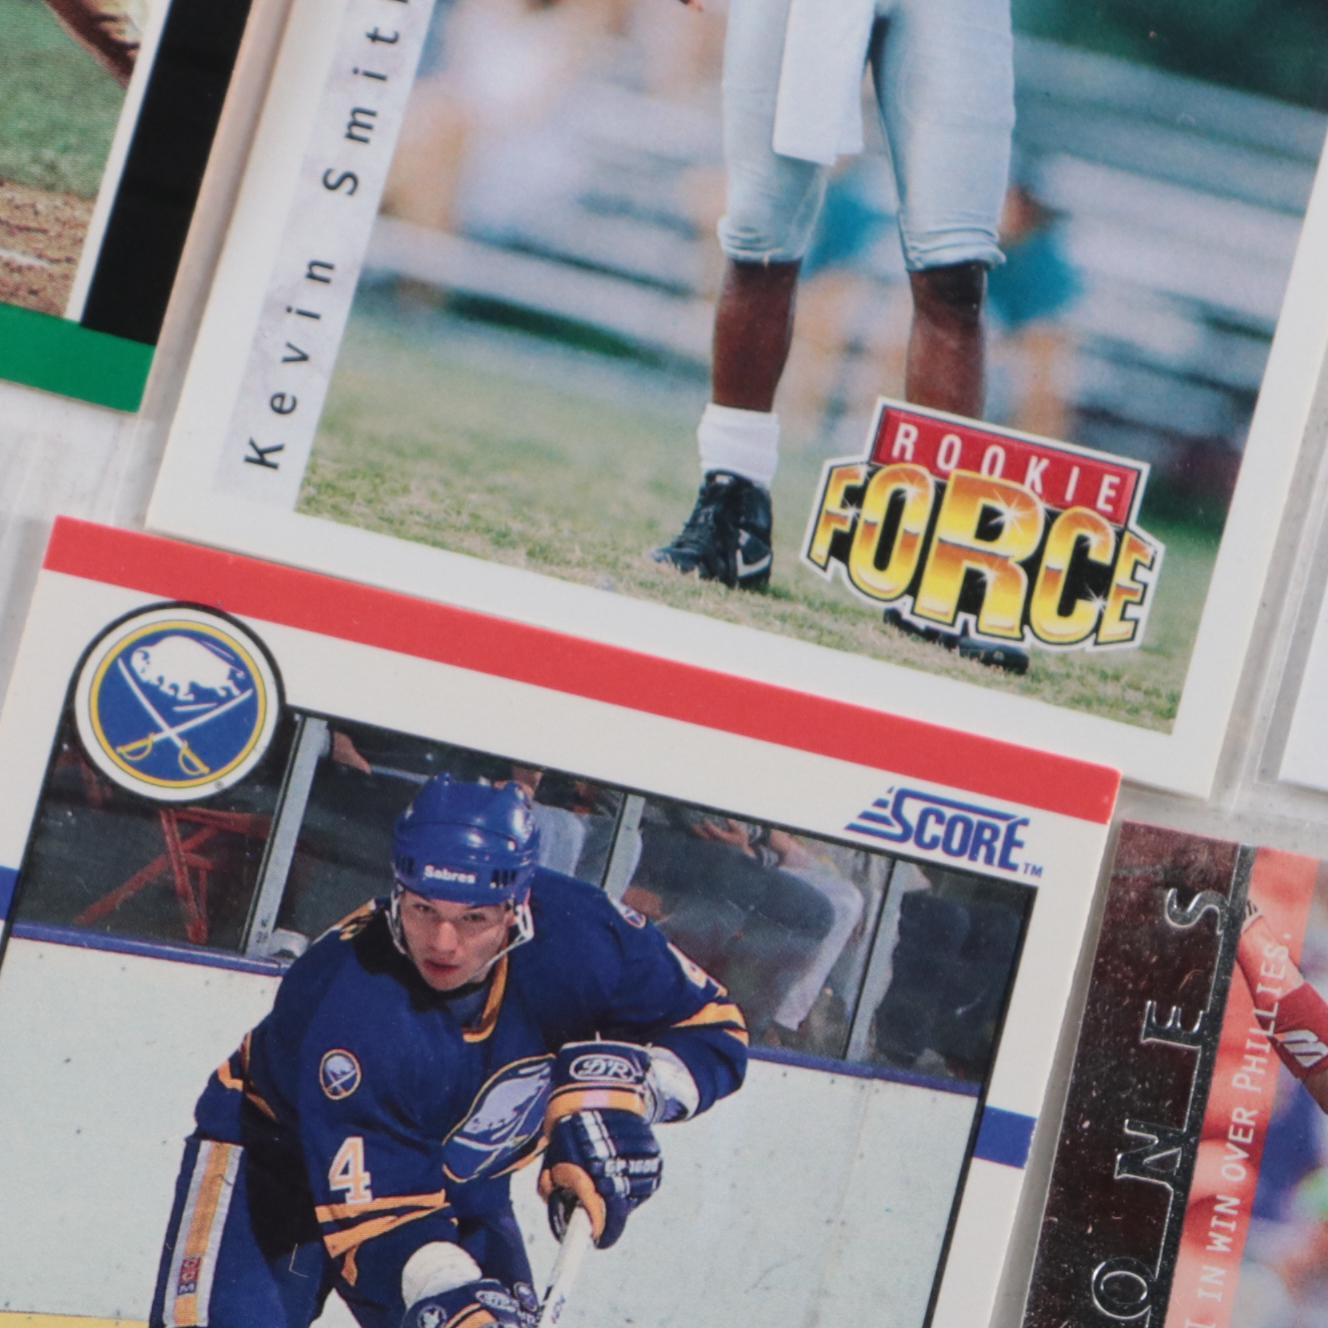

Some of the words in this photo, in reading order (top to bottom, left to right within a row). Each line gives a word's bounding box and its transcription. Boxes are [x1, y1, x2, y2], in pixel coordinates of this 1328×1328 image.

[243, 258, 336, 470] Kevin
[322, 0, 410, 197] Smit
[890, 421, 1122, 513] ROOKIE
[805, 462, 1157, 646] FORCE
[844, 786, 1031, 872] SCORE
[1231, 932, 1293, 1092] PHILLIES.
[328, 1136, 372, 1204] 4
[1221, 1105, 1259, 1184] OVER
[1206, 1193, 1241, 1253] WIN
[1198, 1265, 1226, 1303] IN
